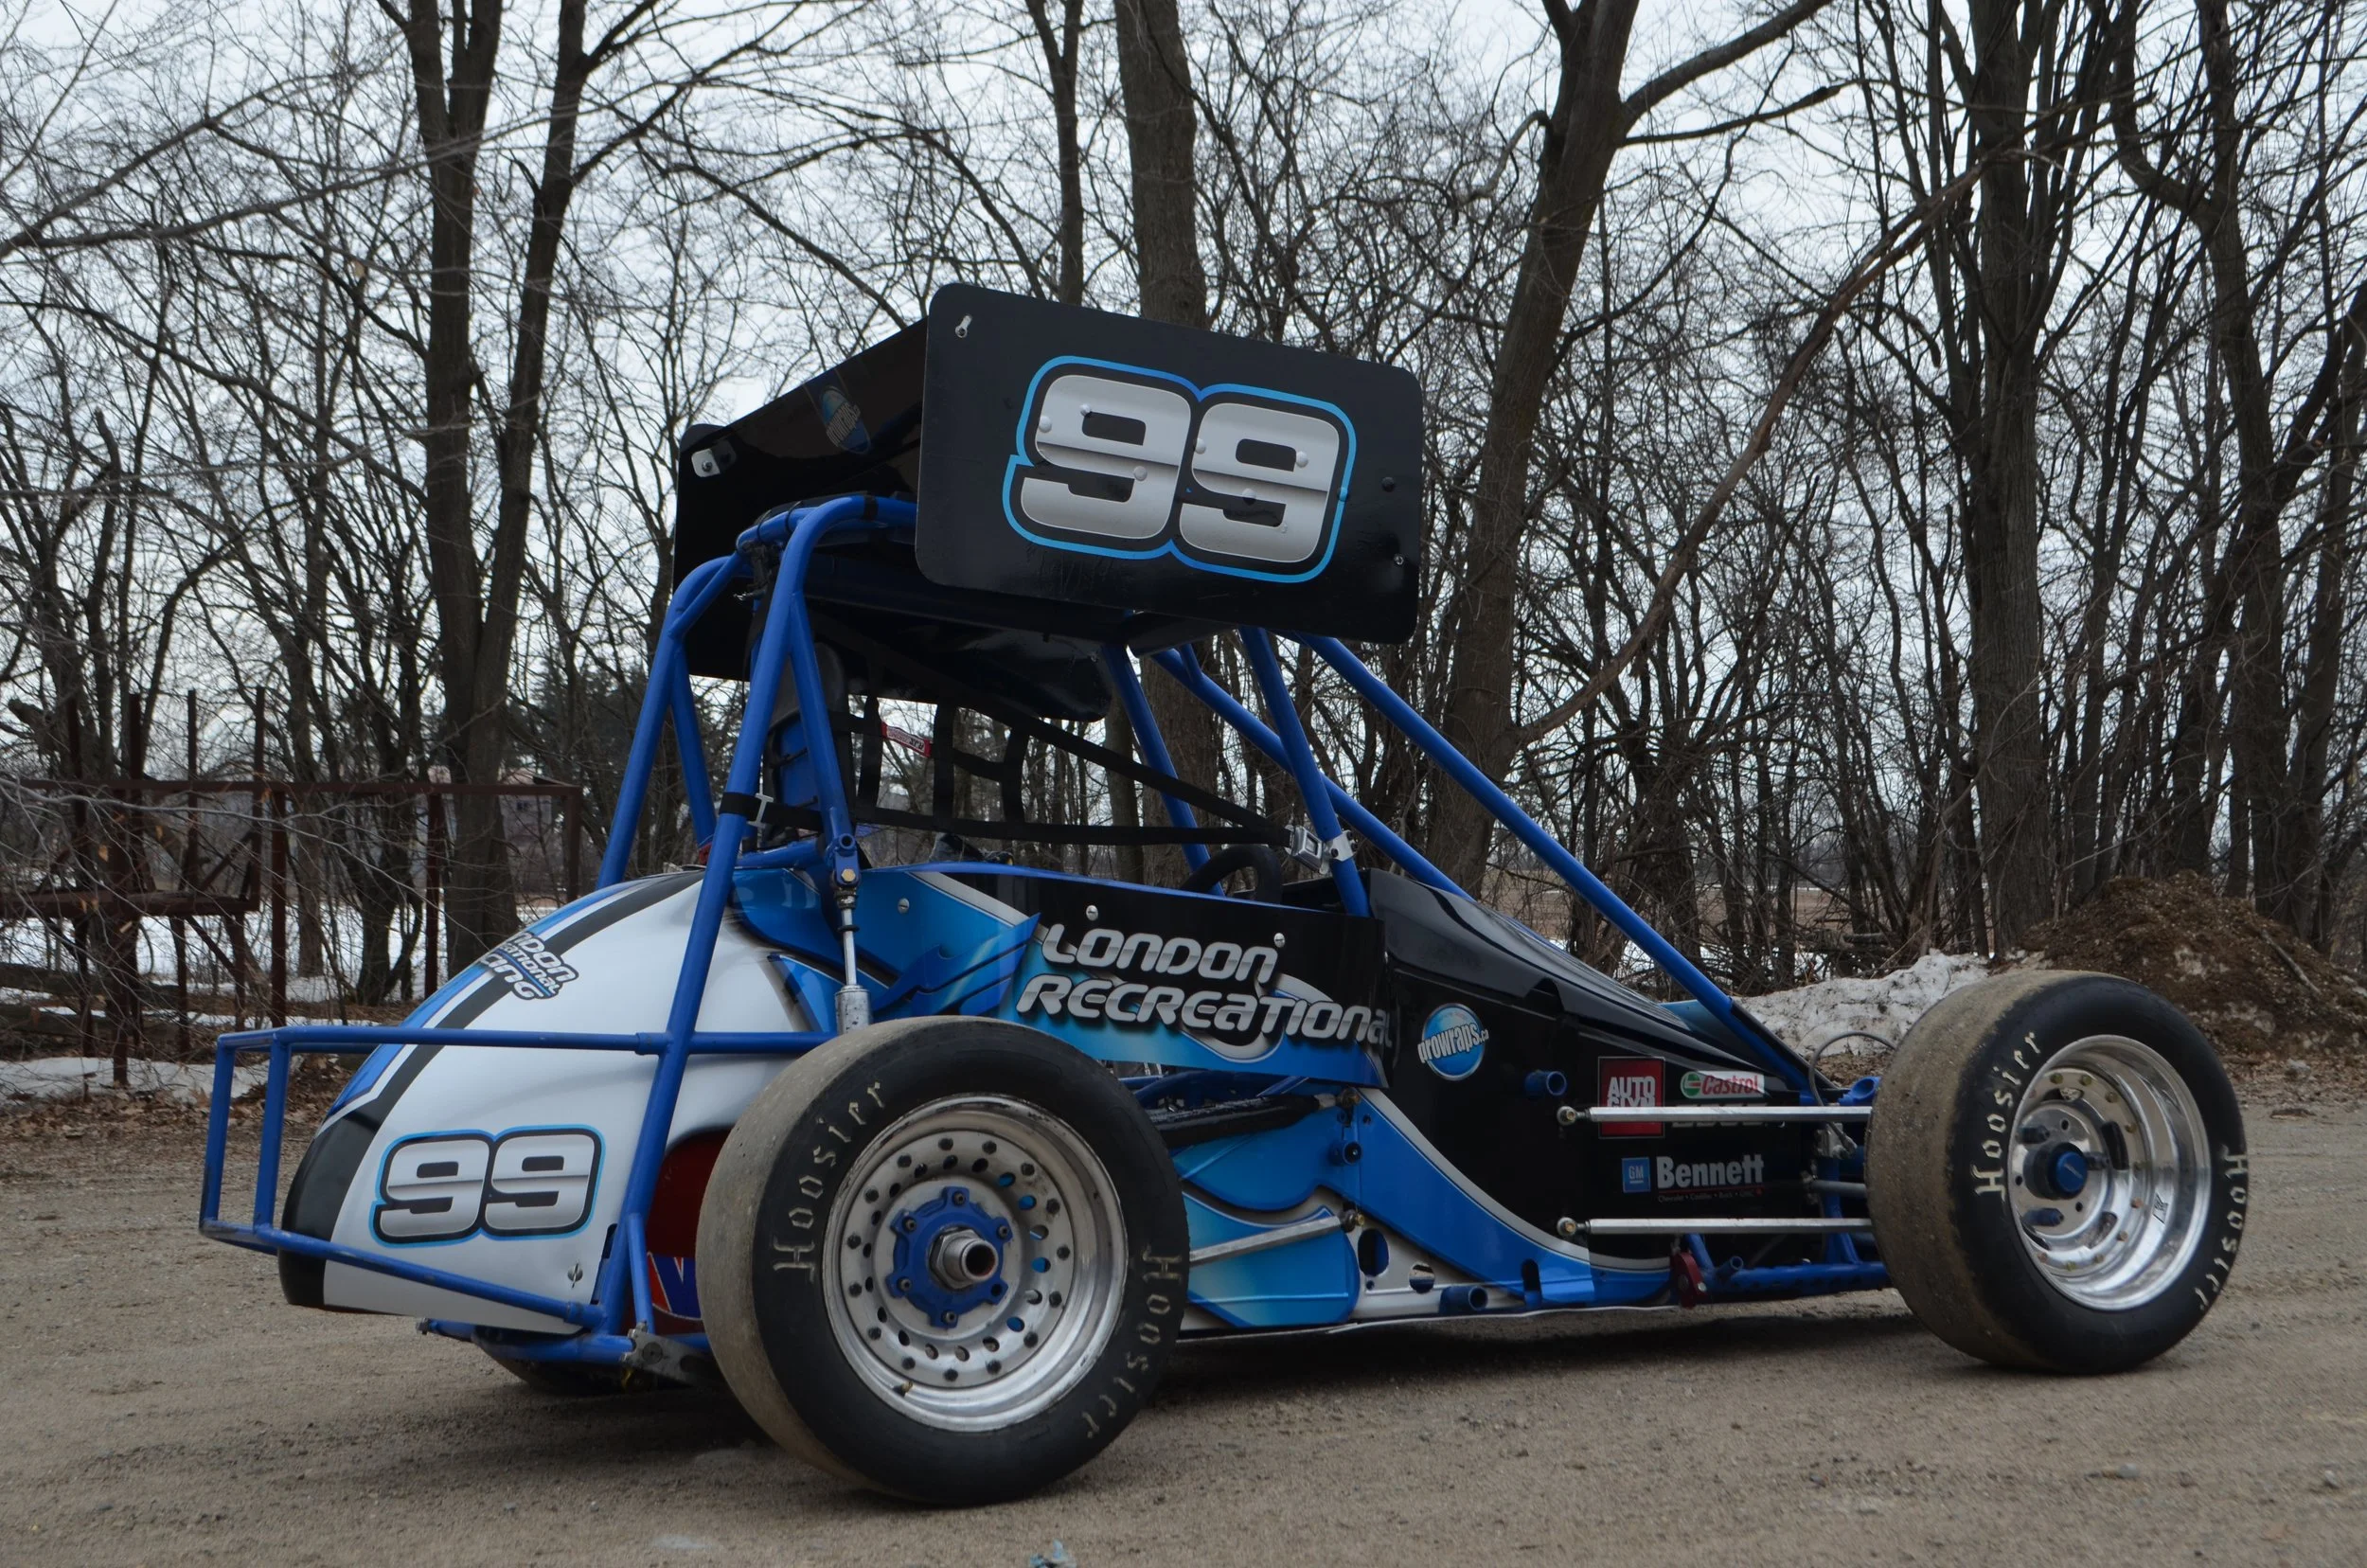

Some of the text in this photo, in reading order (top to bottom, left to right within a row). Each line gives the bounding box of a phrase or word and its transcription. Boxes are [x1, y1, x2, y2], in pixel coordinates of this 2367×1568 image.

[1021, 375, 1341, 563] 99
[1042, 923, 1279, 982] LONDON
[1417, 1023, 1489, 1063] prowraps.ca
[1609, 1076, 1656, 1097] AUTO
[1701, 1073, 1759, 1095] Castrol
[379, 1133, 596, 1238] 99
[1628, 1165, 1645, 1181] GM
[1657, 1154, 1764, 1188] Bennett
